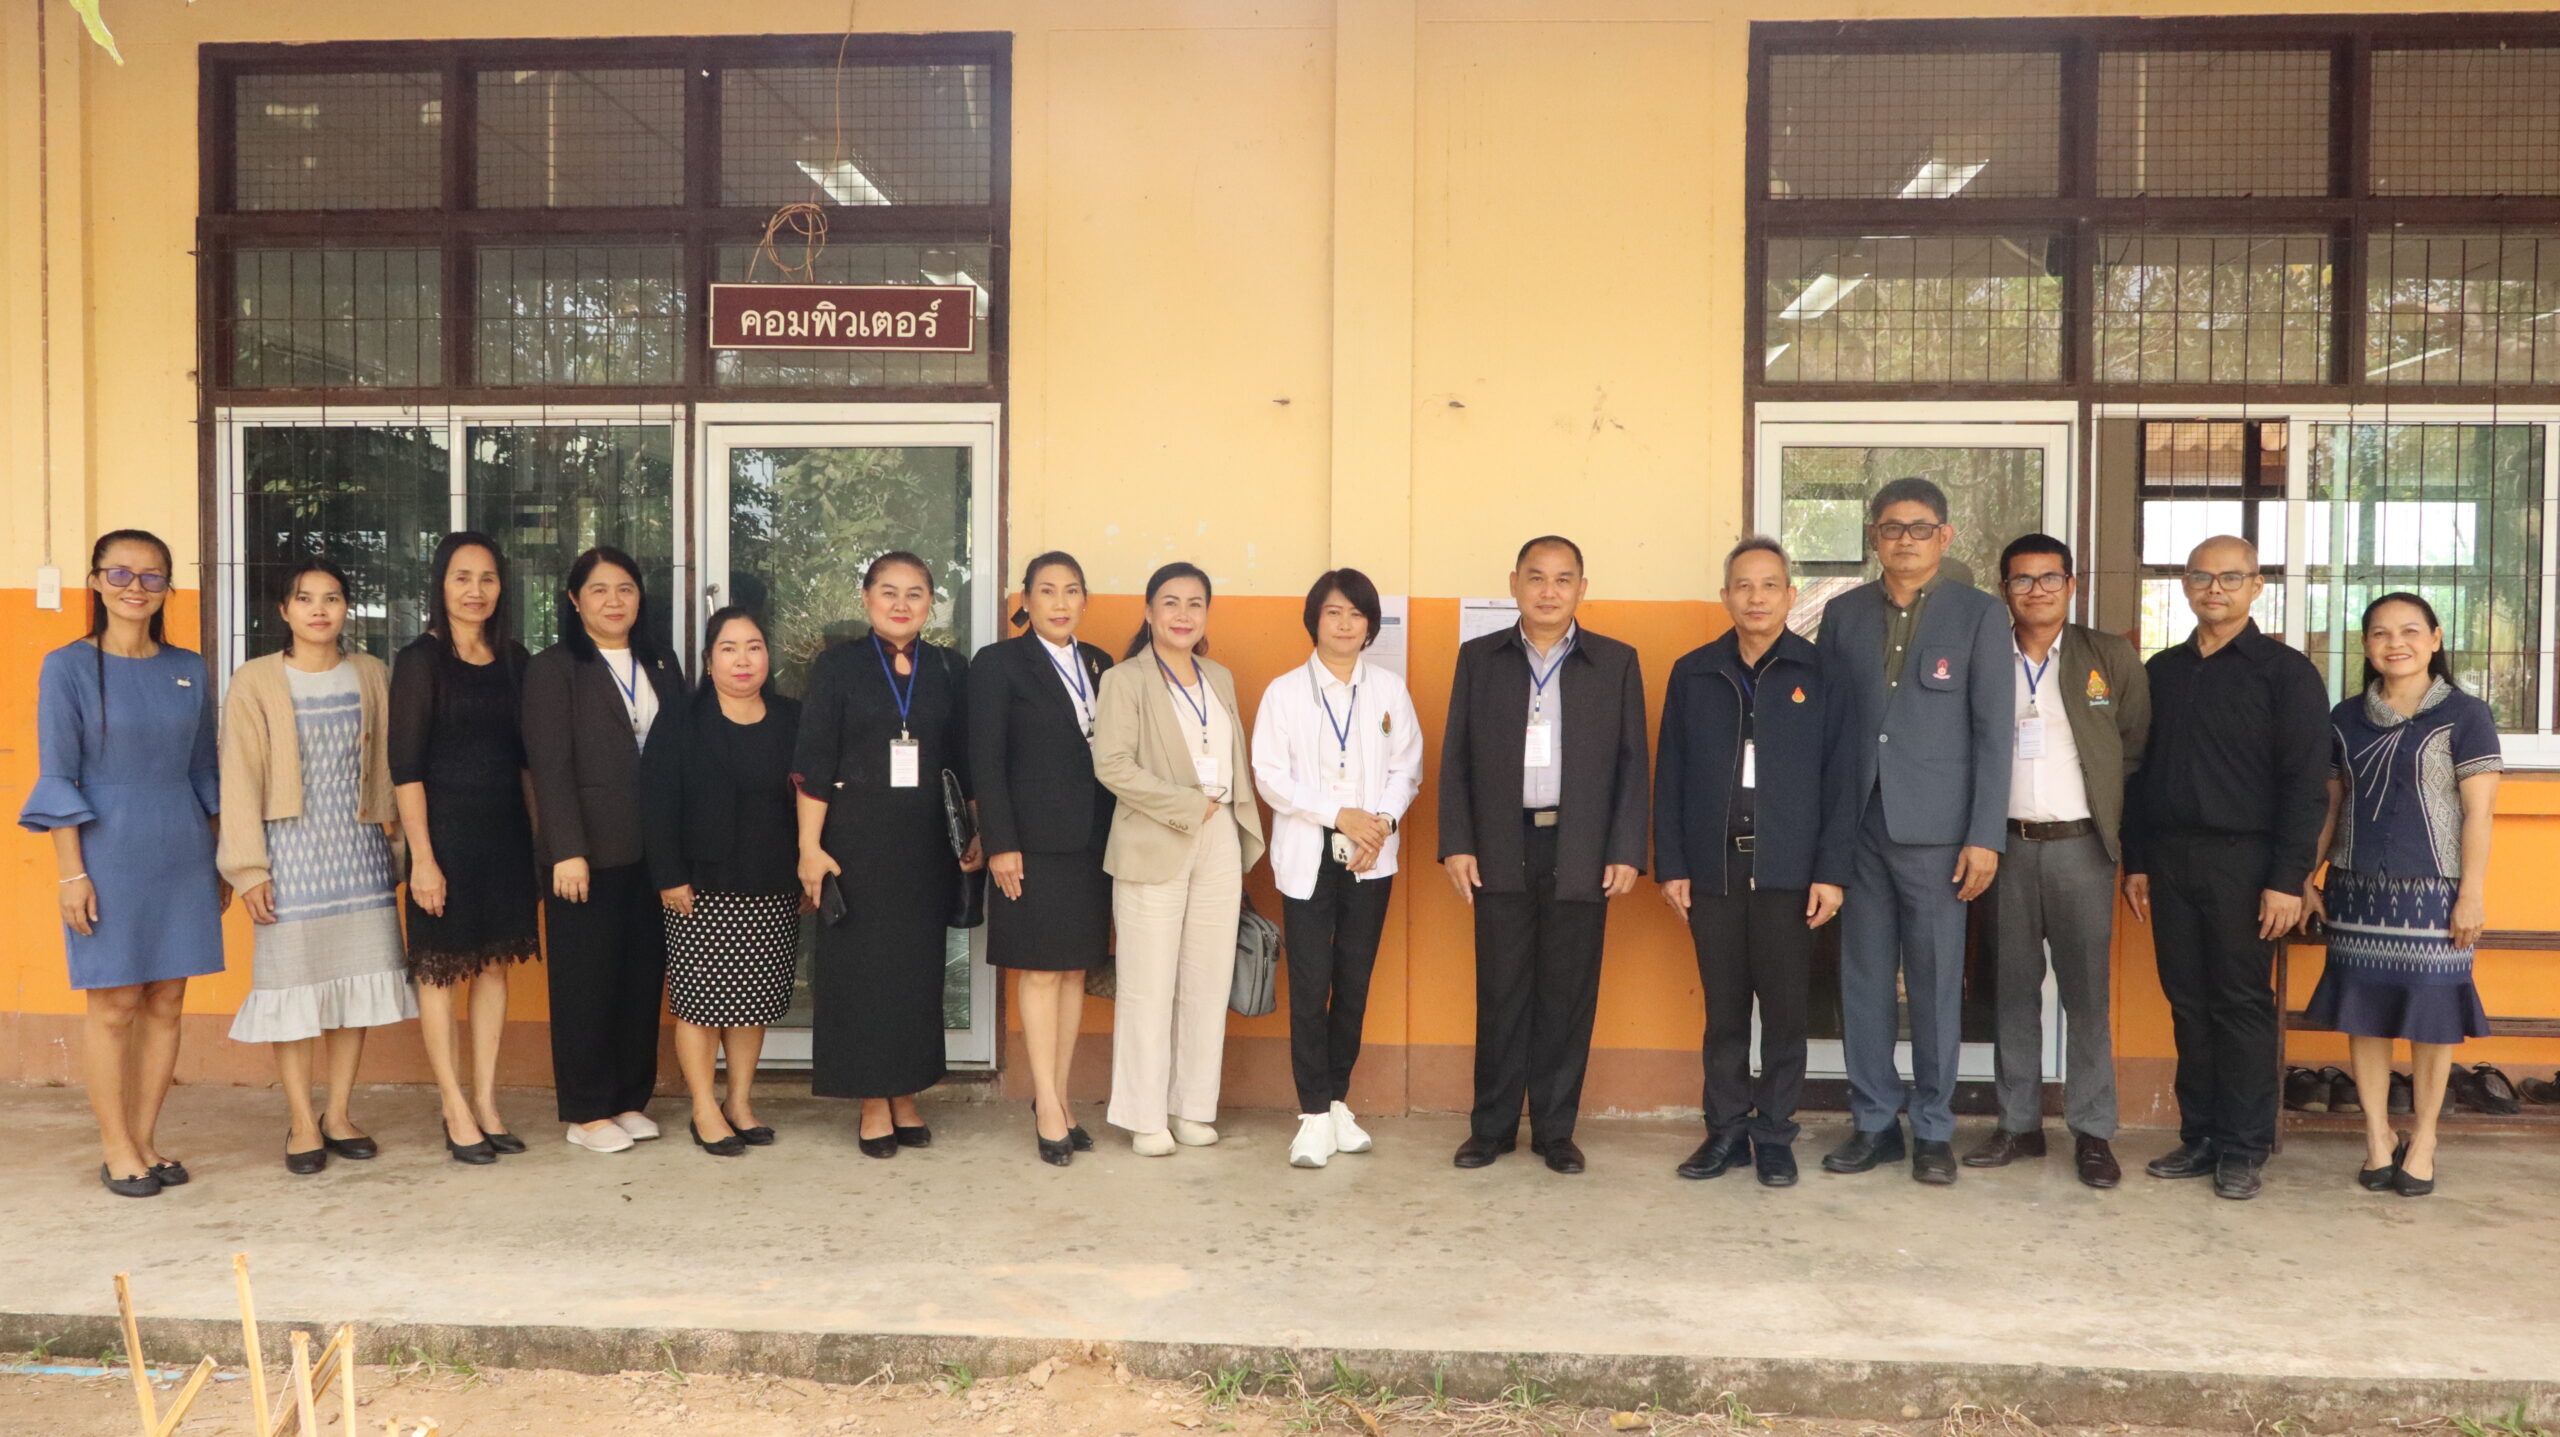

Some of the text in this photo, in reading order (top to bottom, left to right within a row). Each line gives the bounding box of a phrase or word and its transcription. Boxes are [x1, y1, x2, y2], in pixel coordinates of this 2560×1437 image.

[741, 298, 942, 338] คอมพิวเตอร์
